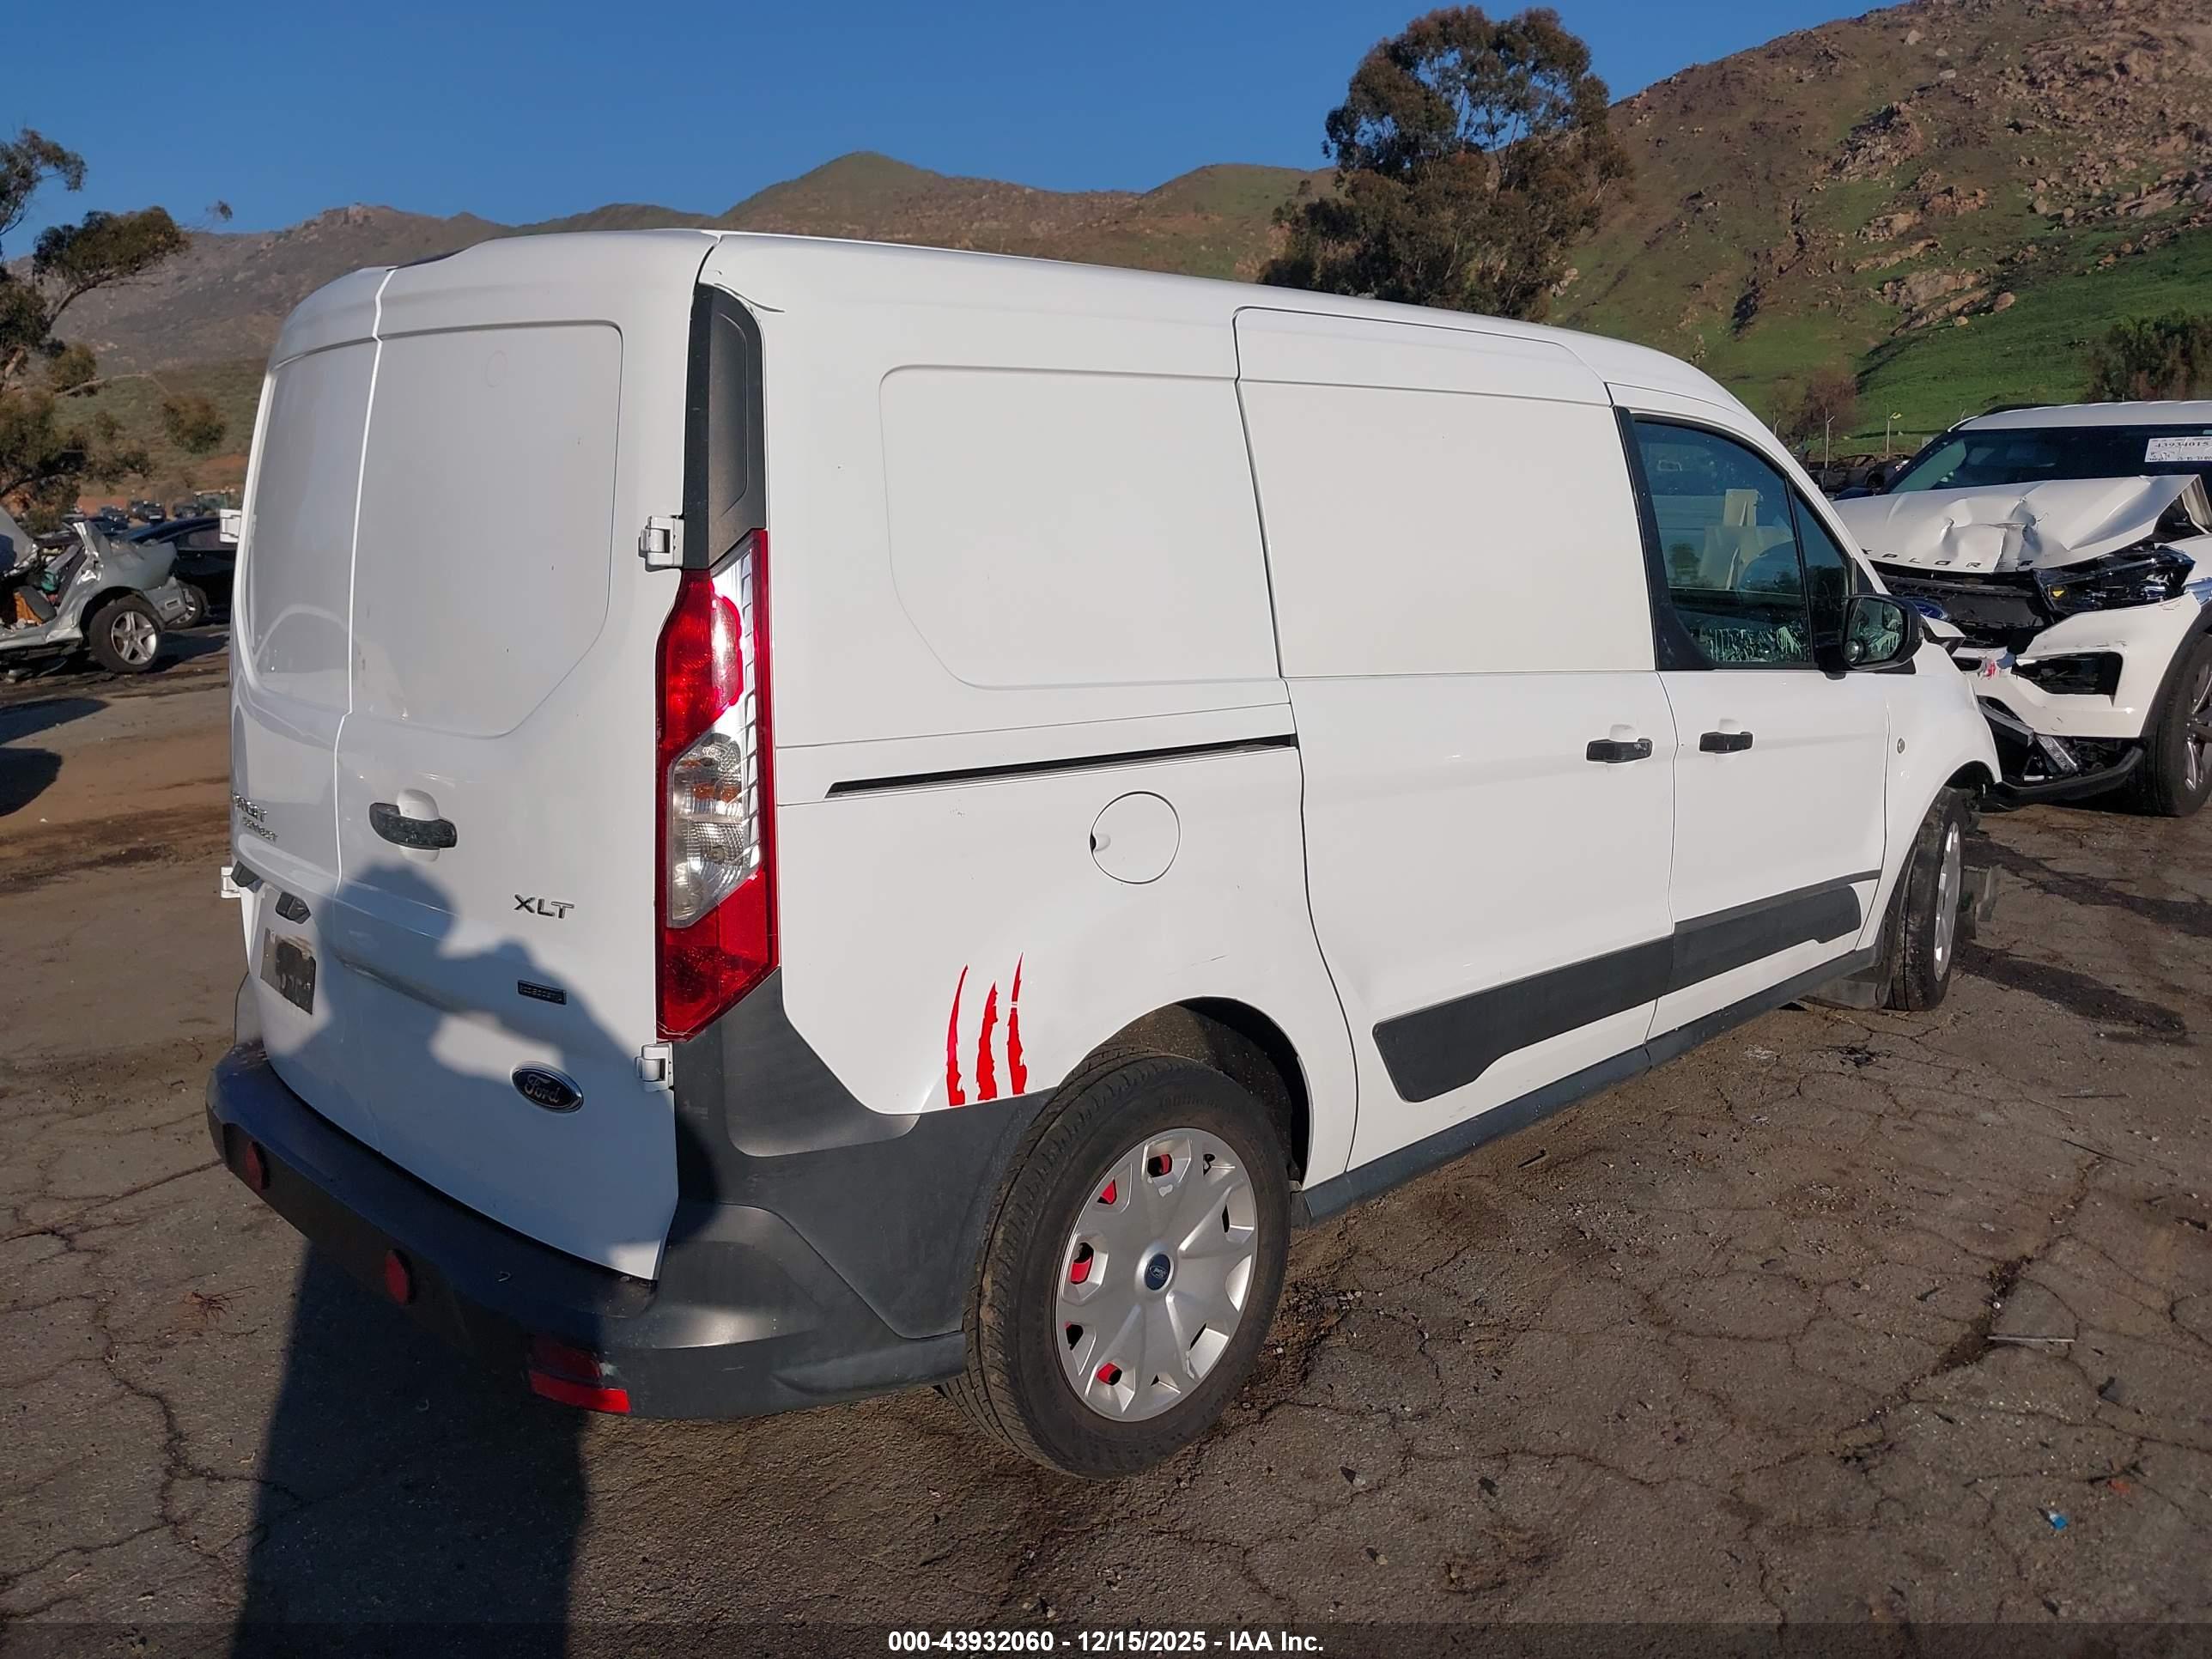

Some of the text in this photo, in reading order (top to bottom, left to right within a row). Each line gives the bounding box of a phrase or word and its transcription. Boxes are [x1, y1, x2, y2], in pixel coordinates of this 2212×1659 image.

[1861, 547, 2034, 570] XPLORER
[514, 894, 575, 919] XLT
[524, 1073, 562, 1103] Ford
